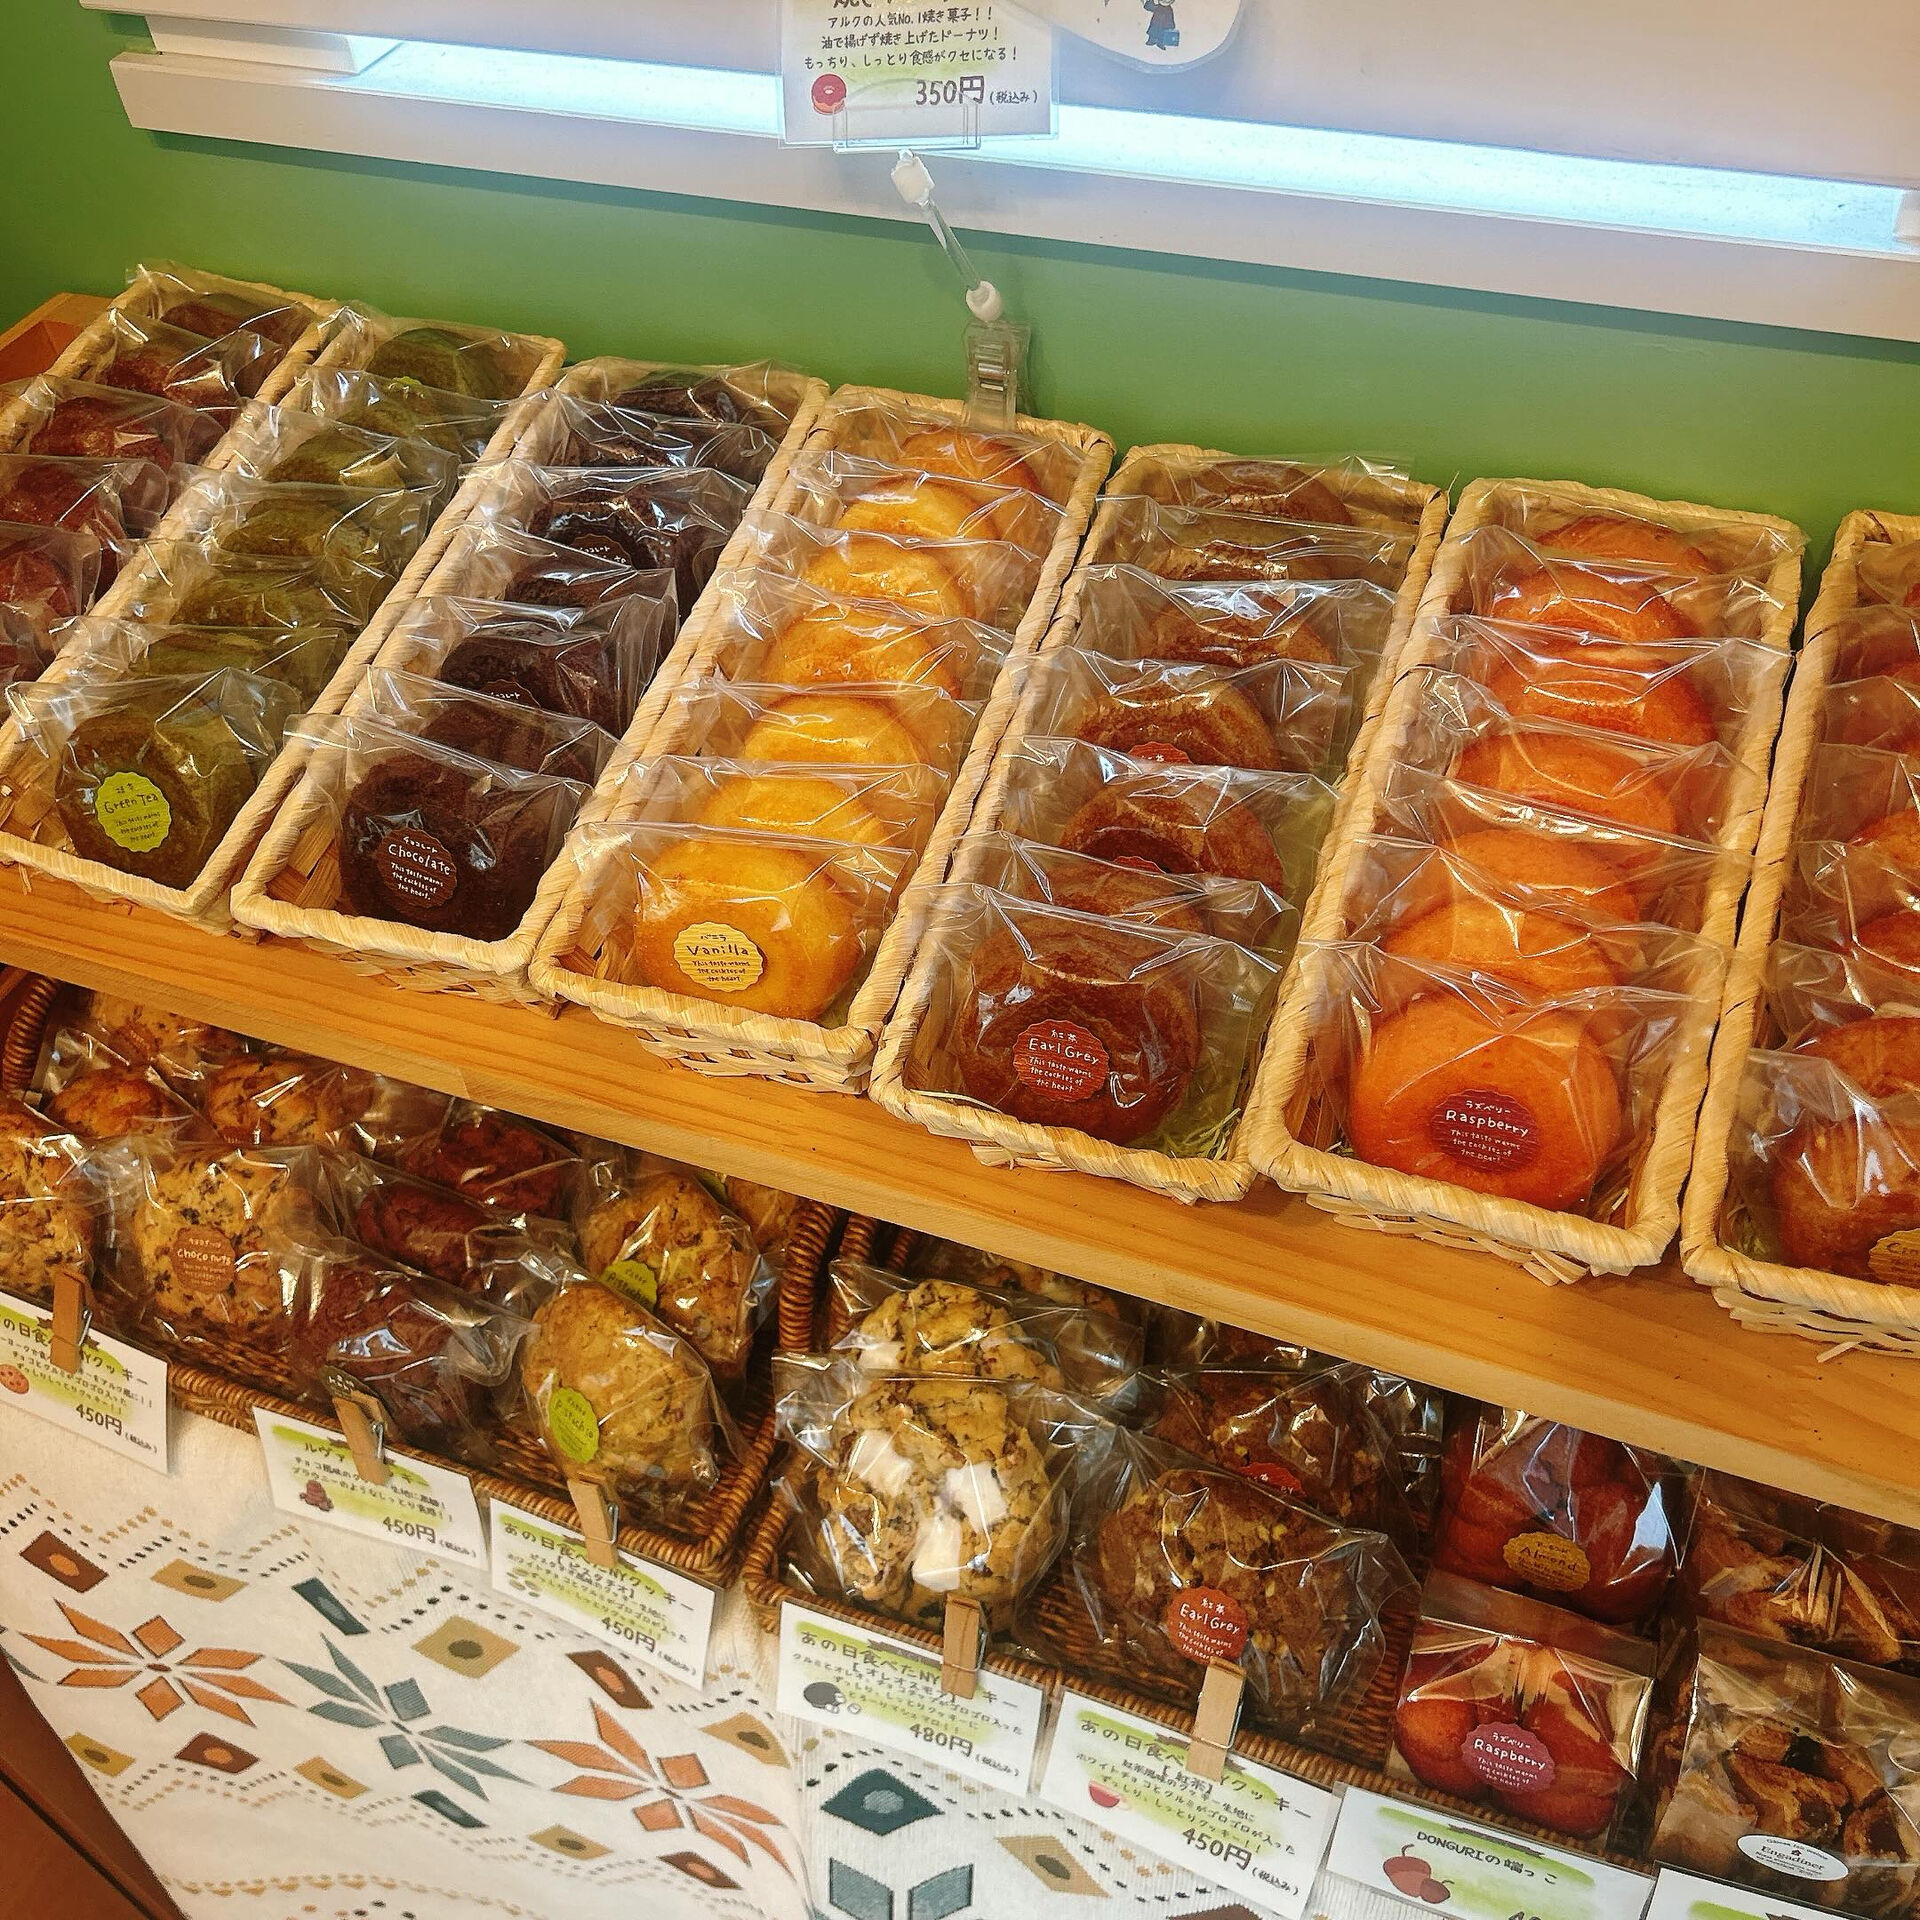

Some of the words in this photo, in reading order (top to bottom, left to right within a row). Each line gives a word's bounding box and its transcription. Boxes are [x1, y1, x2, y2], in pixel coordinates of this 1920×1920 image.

[915, 75, 985, 105] 350円
[104, 799, 138, 814] Green
[136, 793, 159, 806] Tea
[388, 843, 451, 876] Chocolate
[686, 943, 749, 956] Vanilla
[1028, 1038, 1061, 1054] Earl
[1064, 1045, 1099, 1065] Grey
[1029, 1056, 1046, 1066] This
[1030, 1066, 1043, 1076] the
[1074, 1078, 1083, 1087] of
[1036, 1078, 1049, 1088] the
[1465, 1099, 1512, 1114] ラズベリー
[1445, 1109, 1529, 1138] Raspberry
[75, 1403, 123, 1436] 450円
[382, 1515, 436, 1544] 450円
[1519, 1546, 1577, 1572] Almond
[1179, 1602, 1209, 1625] Earl
[1209, 1616, 1240, 1635] Grey
[601, 1616, 657, 1653] 450円
[1215, 1648, 1224, 1657] of
[909, 1722, 974, 1758] 480円
[1473, 1738, 1546, 1770] Raspberry
[1492, 1731, 1531, 1749] ラズベリー
[1182, 1827, 1254, 1872] 450円
